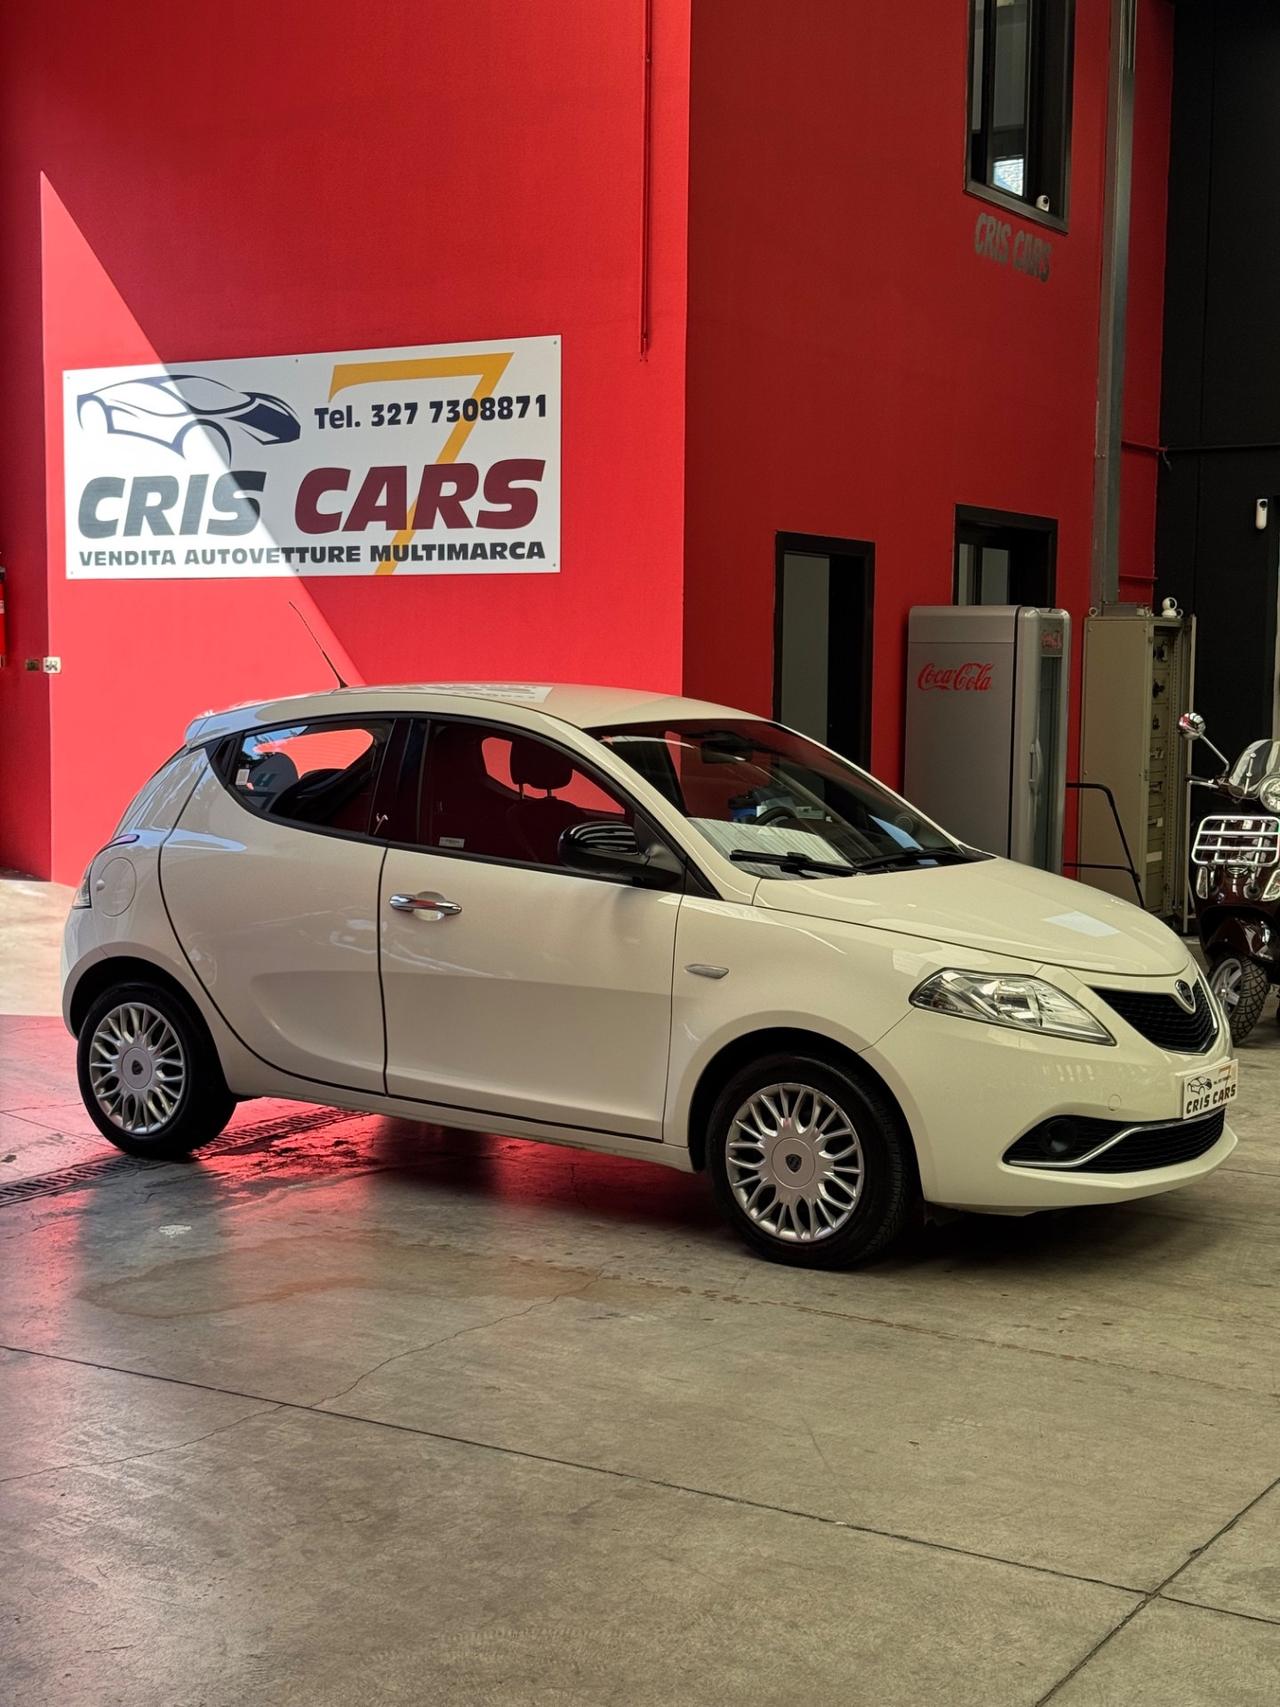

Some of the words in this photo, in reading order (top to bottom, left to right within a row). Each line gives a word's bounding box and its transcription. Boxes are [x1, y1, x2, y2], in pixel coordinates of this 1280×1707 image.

[975, 212, 1012, 265] CRIS
[314, 406, 361, 430] Tel.
[371, 401, 418, 427] 327
[429, 394, 547, 424] 7308871
[78, 470, 267, 540] CRIS
[294, 458, 546, 534] CARS
[79, 549, 177, 567] VENDITA
[184, 545, 361, 566] AUTOVETTURE
[370, 541, 546, 563] MULTIMARCA
[1186, 1094, 1210, 1114] CRIS
[1212, 1083, 1236, 1104] CARS
